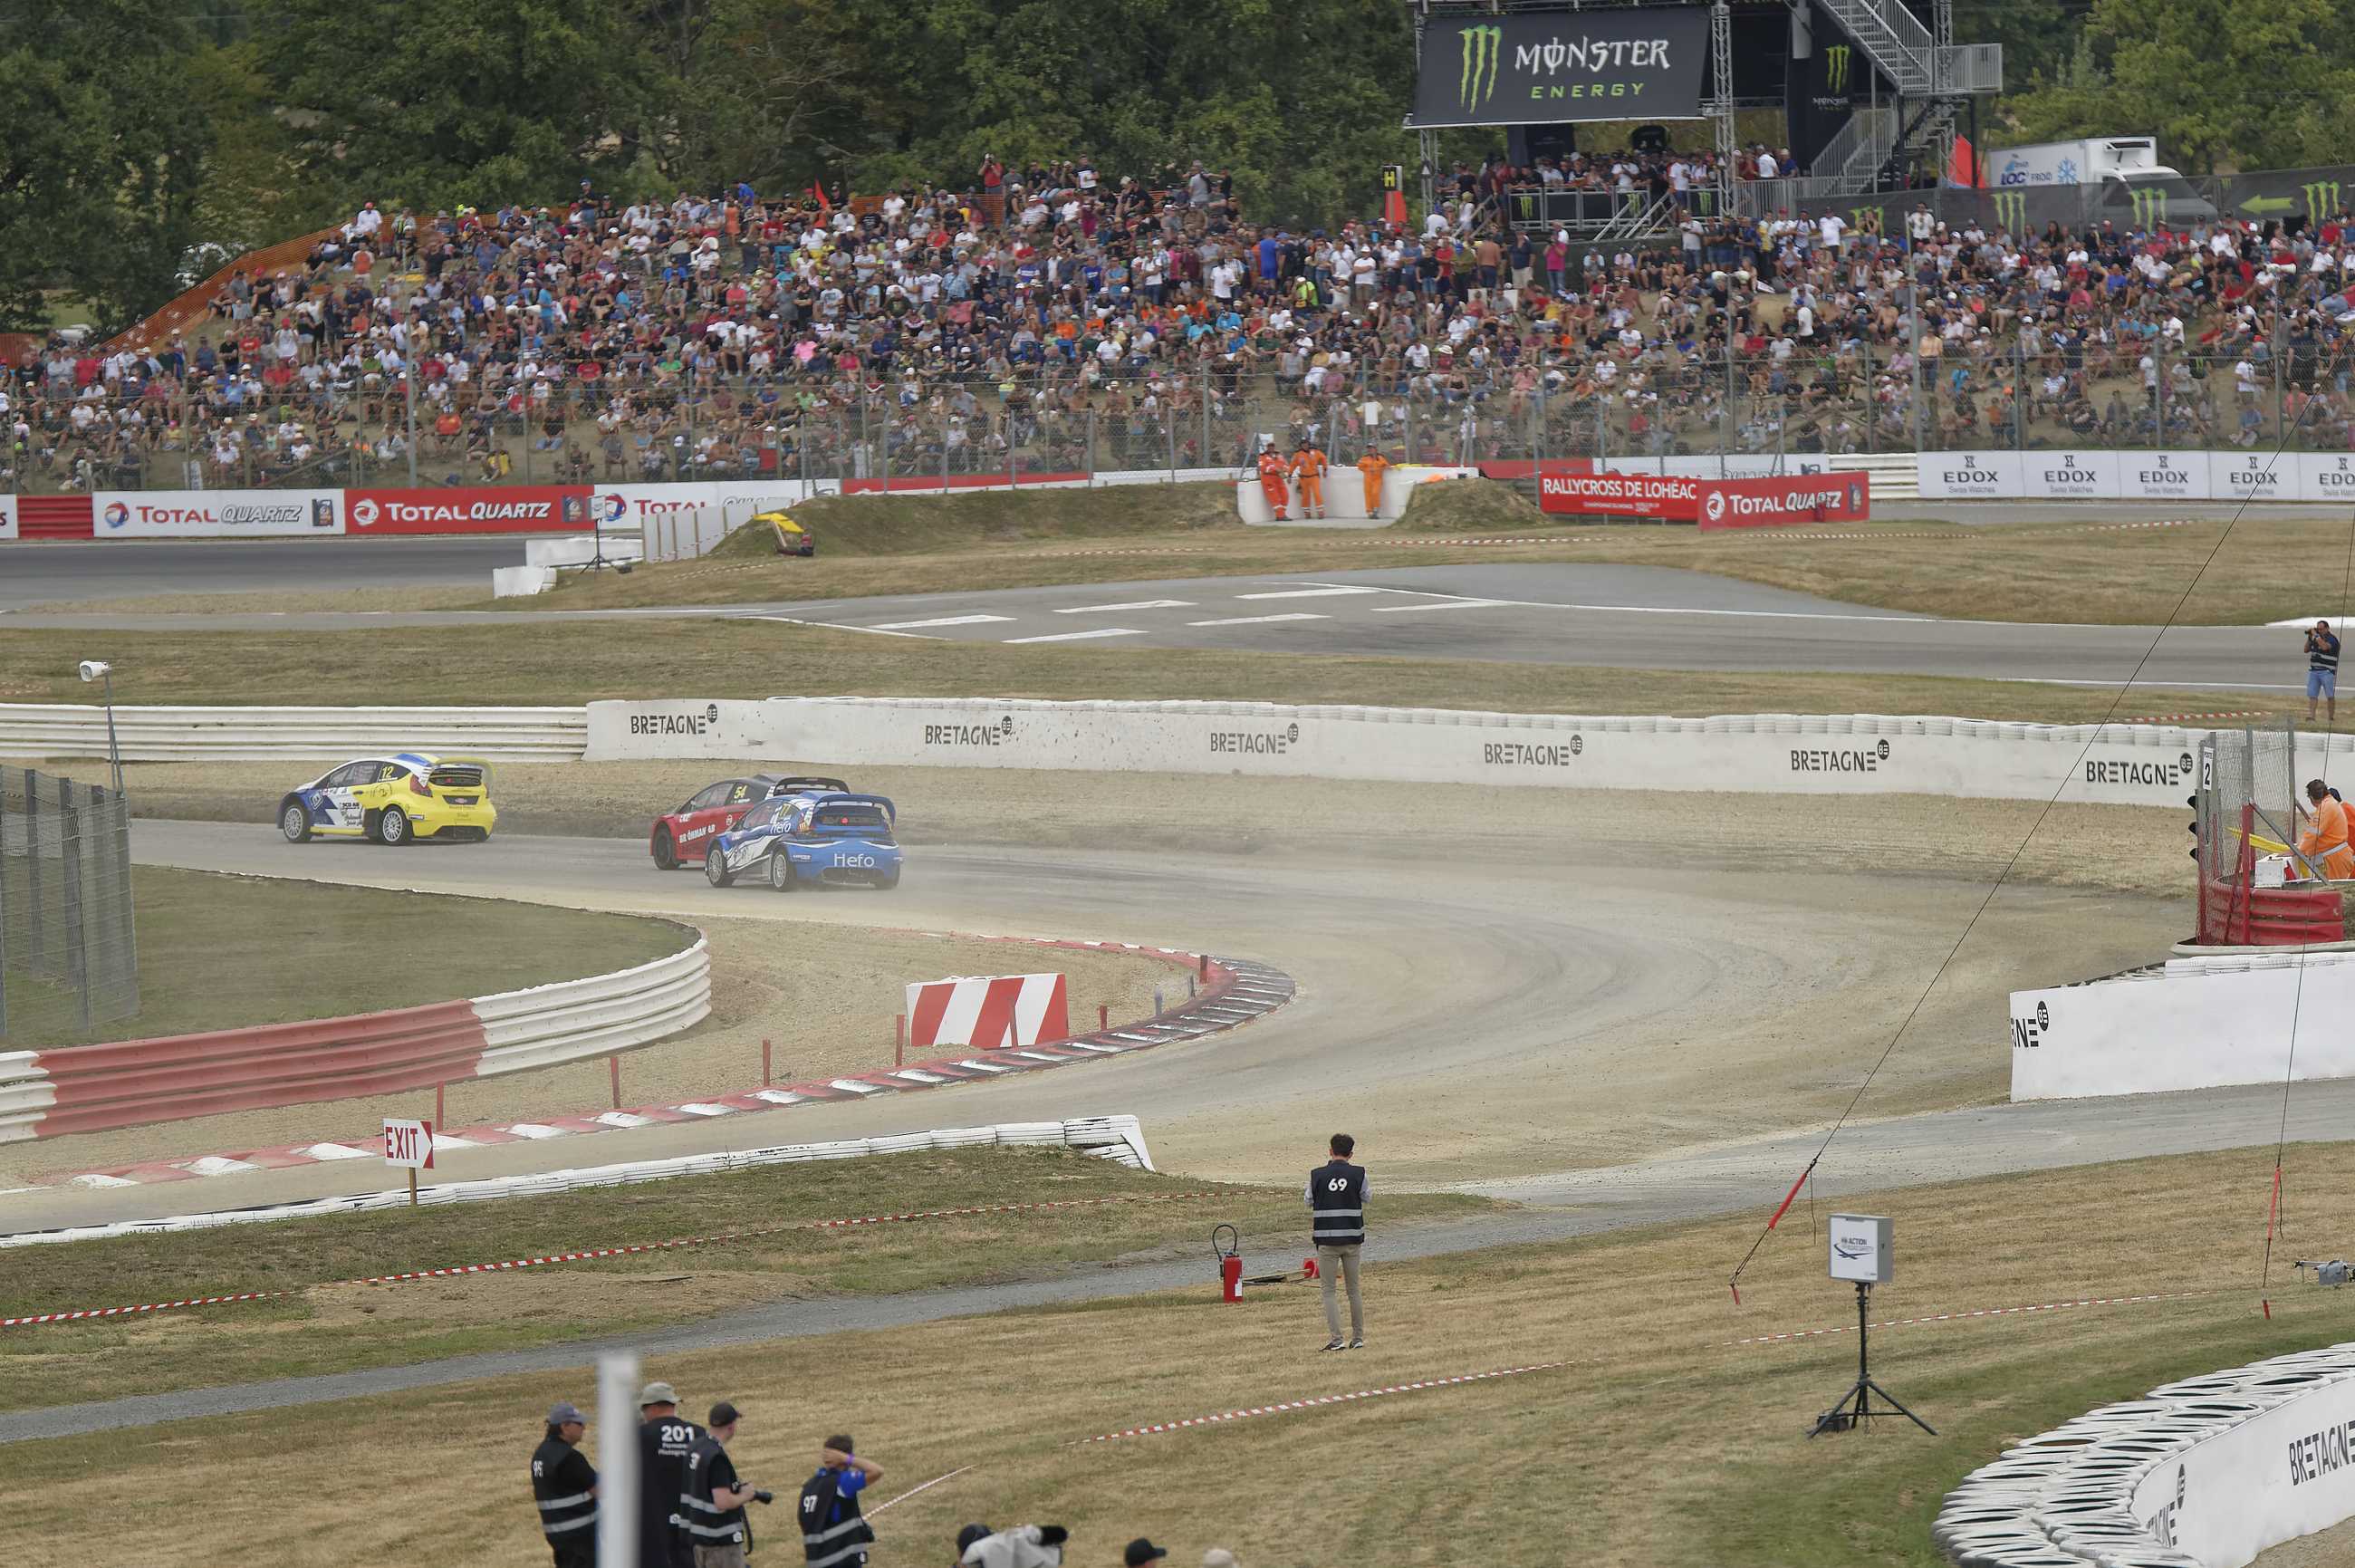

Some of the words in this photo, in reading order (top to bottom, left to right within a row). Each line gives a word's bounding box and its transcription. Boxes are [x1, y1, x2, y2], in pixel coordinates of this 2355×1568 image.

[1514, 36, 1671, 75] MONSTER
[1531, 82, 1645, 100] ENERGY
[1384, 171, 1395, 187] H
[2001, 172, 2026, 185] LOC
[1944, 471, 1998, 483] EDOX
[2044, 470, 2096, 483] EDOX
[2139, 471, 2189, 484] EDOX
[2230, 472, 2278, 485] EDOX
[1543, 478, 1622, 495] RALLYCROSS
[1625, 481, 1643, 497] DE
[1645, 479, 1697, 499] LOHÉAC
[385, 503, 467, 522] TOTAL
[470, 502, 552, 520] QUARTZ
[1729, 495, 1784, 515] TOTAL
[136, 505, 218, 524] TOTAL
[221, 505, 303, 524] QUARTZ
[630, 715, 706, 735] BRETAGNE
[926, 726, 1001, 746] BRETAGNE
[1211, 732, 1286, 754] BRETAGNE
[1485, 744, 1570, 766] BRETAGNE
[1791, 750, 1877, 772] BRETAGNE
[382, 766, 393, 778] 12
[2086, 761, 2179, 785] BRETAGNE
[2205, 763, 2211, 785] 2
[735, 785, 747, 798] 54
[833, 853, 874, 867] Hefo
[385, 1127, 418, 1159] EXIT
[1328, 1178, 1348, 1192] 69
[661, 1425, 694, 1442] 201
[803, 1495, 818, 1513] 97
